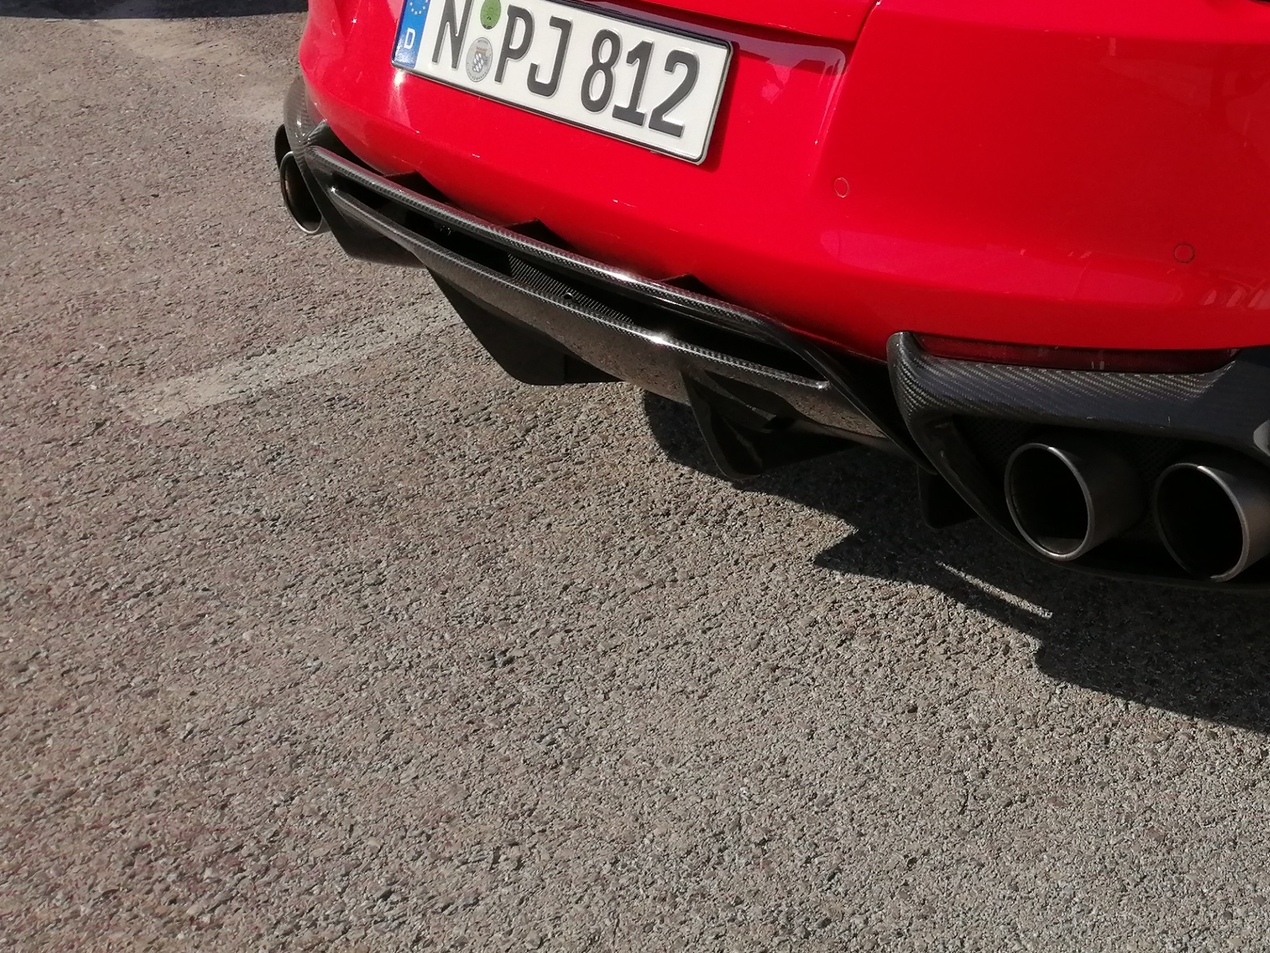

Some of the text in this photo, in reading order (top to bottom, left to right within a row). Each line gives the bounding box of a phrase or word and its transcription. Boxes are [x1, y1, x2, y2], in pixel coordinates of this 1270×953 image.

[402, 27, 416, 51] D
[494, 3, 572, 98] PJ
[580, 28, 701, 138] 812
